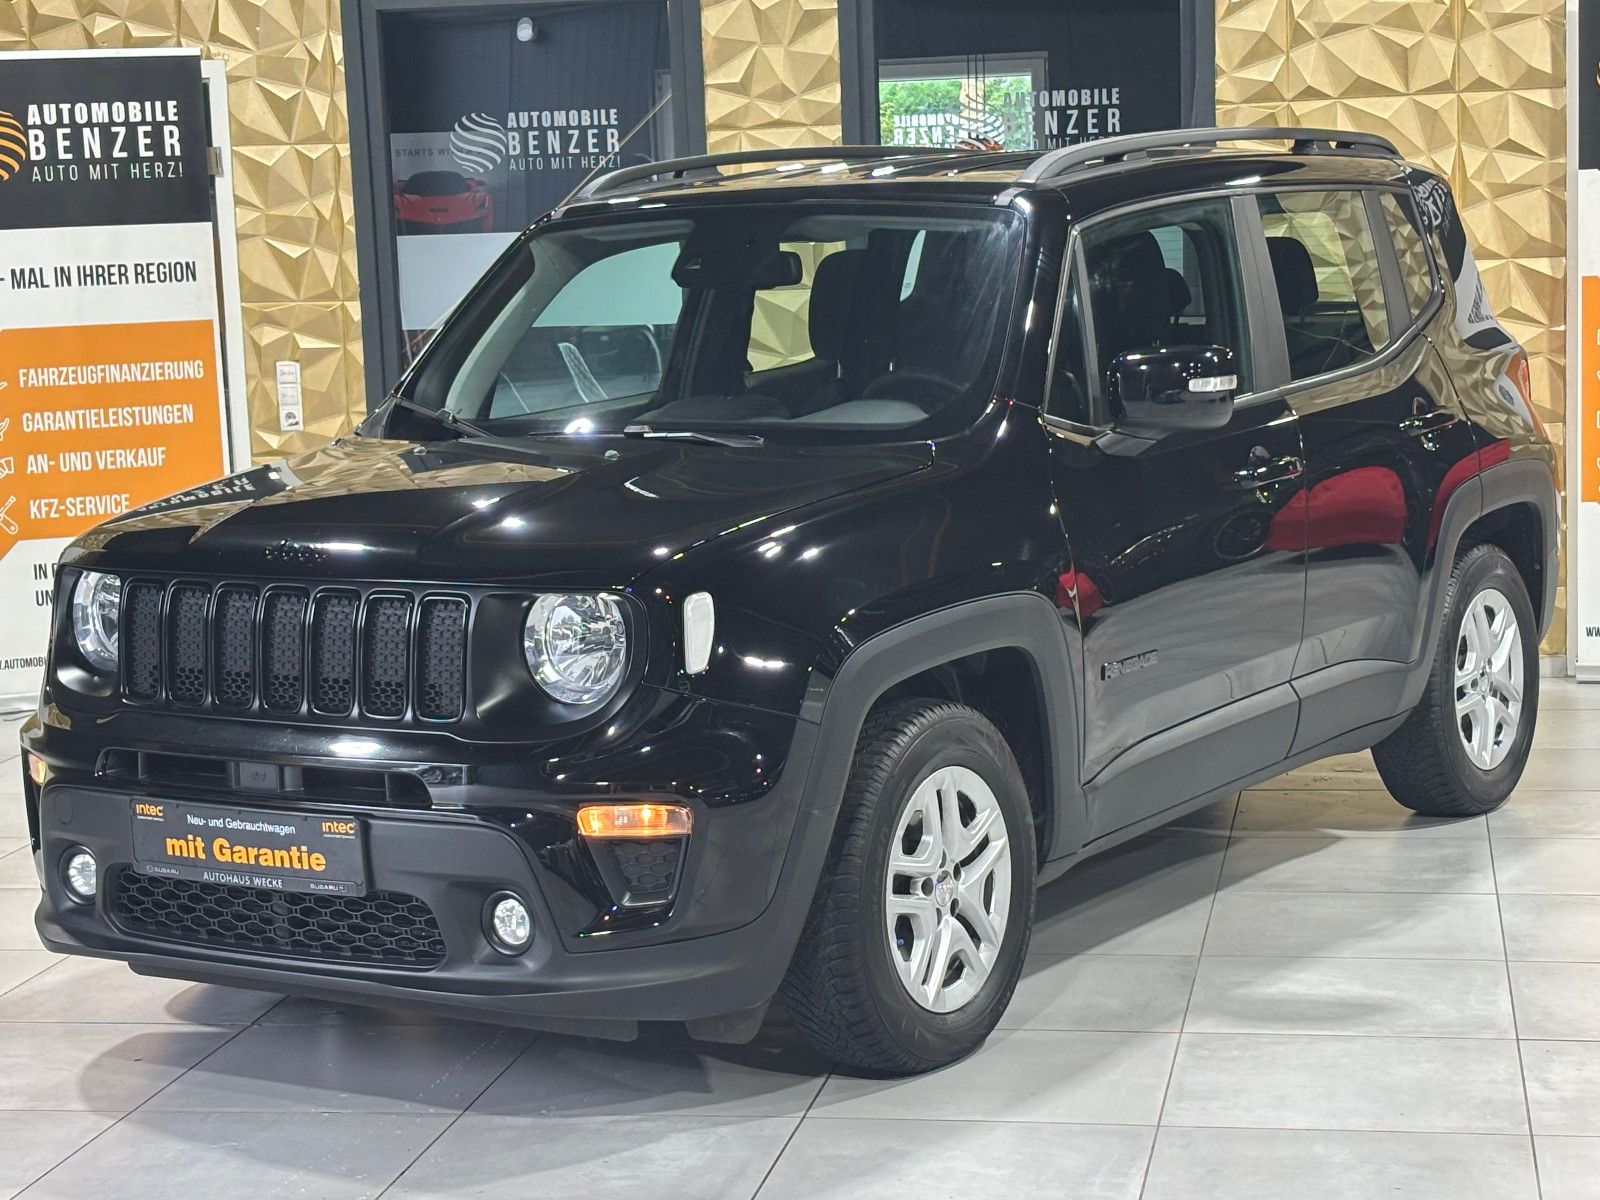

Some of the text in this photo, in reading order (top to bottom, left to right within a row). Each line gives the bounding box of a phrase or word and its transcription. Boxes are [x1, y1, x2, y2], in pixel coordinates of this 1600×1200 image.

[27, 100, 179, 125] AUTOMOBILE
[507, 109, 619, 128] AUTOMOBILE
[28, 125, 182, 161] BENZER
[508, 128, 620, 155] BENZER
[32, 162, 184, 182] AUTO MIT HERZ!
[509, 155, 621, 171] AUTO MIT HERZ!
[10, 267, 50, 290] MAL
[54, 265, 72, 288] IN
[77, 263, 130, 287] IHRER
[134, 261, 197, 285] REGION
[19, 360, 204, 388] FAHRZEUGFINANZIERUNG
[22, 404, 194, 433] GARANTIELEISTUNGEN
[27, 447, 166, 474] AN- UND VERKAUF
[29, 493, 130, 519] KFZ-SERVICE
[33, 563, 48, 580] IN
[136, 803, 164, 816] intec
[187, 814, 296, 836] Neu- und Gebrauchtwagen
[322, 821, 356, 834] intec
[166, 834, 326, 871] mit Garantie
[154, 866, 179, 875] SUBARU
[203, 871, 283, 888] AUTOHAUS WECKE
[309, 883, 339, 891] SUBARU
